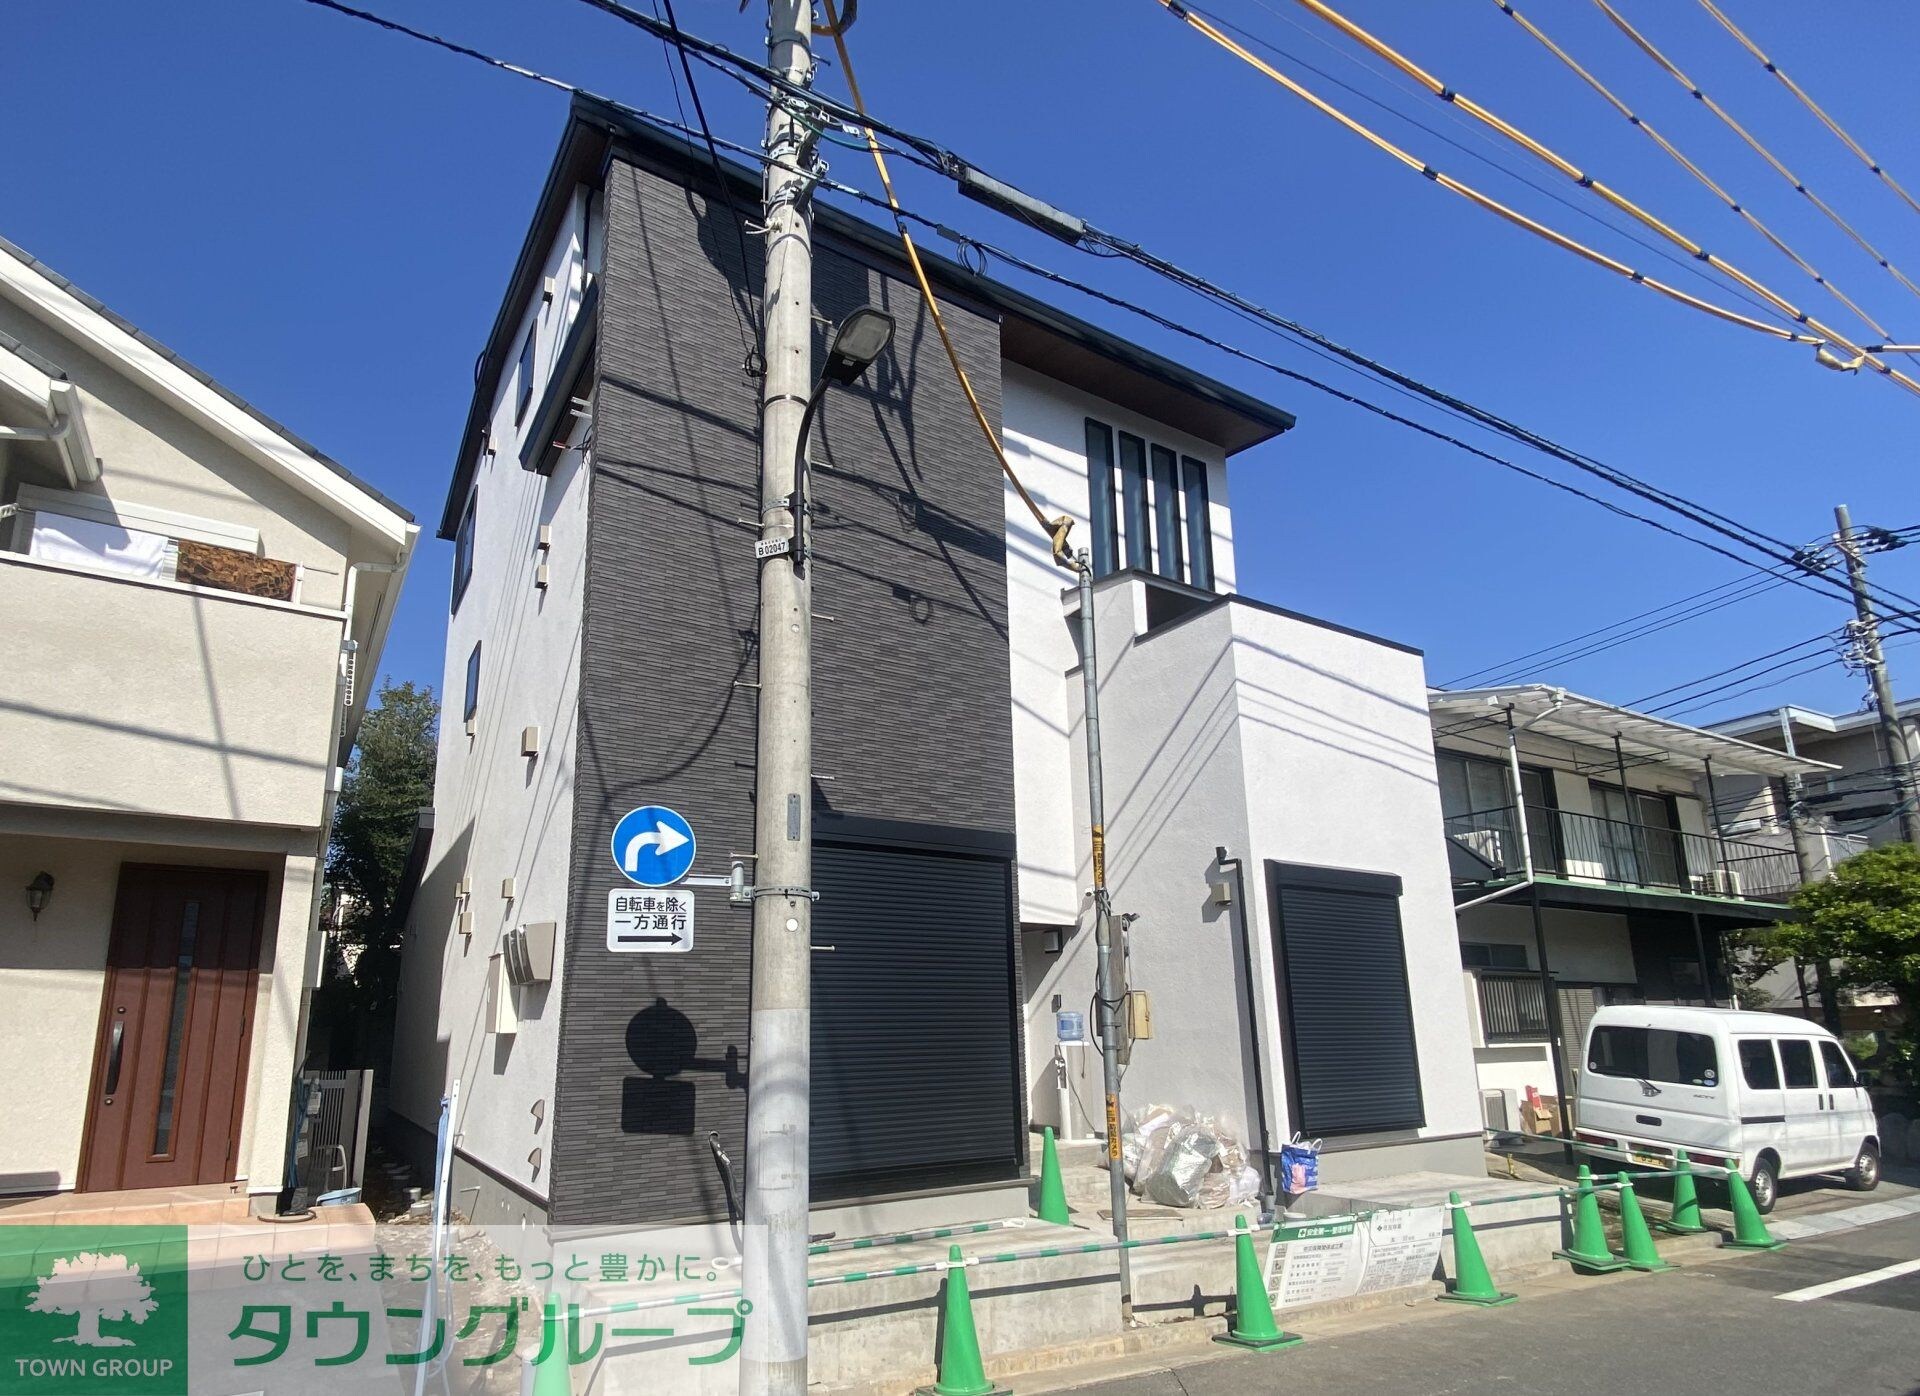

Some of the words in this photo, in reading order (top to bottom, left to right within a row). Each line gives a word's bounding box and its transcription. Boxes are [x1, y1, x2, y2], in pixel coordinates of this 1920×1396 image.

[616, 897, 687, 911] 自転車を除く
[615, 914, 687, 930] 一方通行
